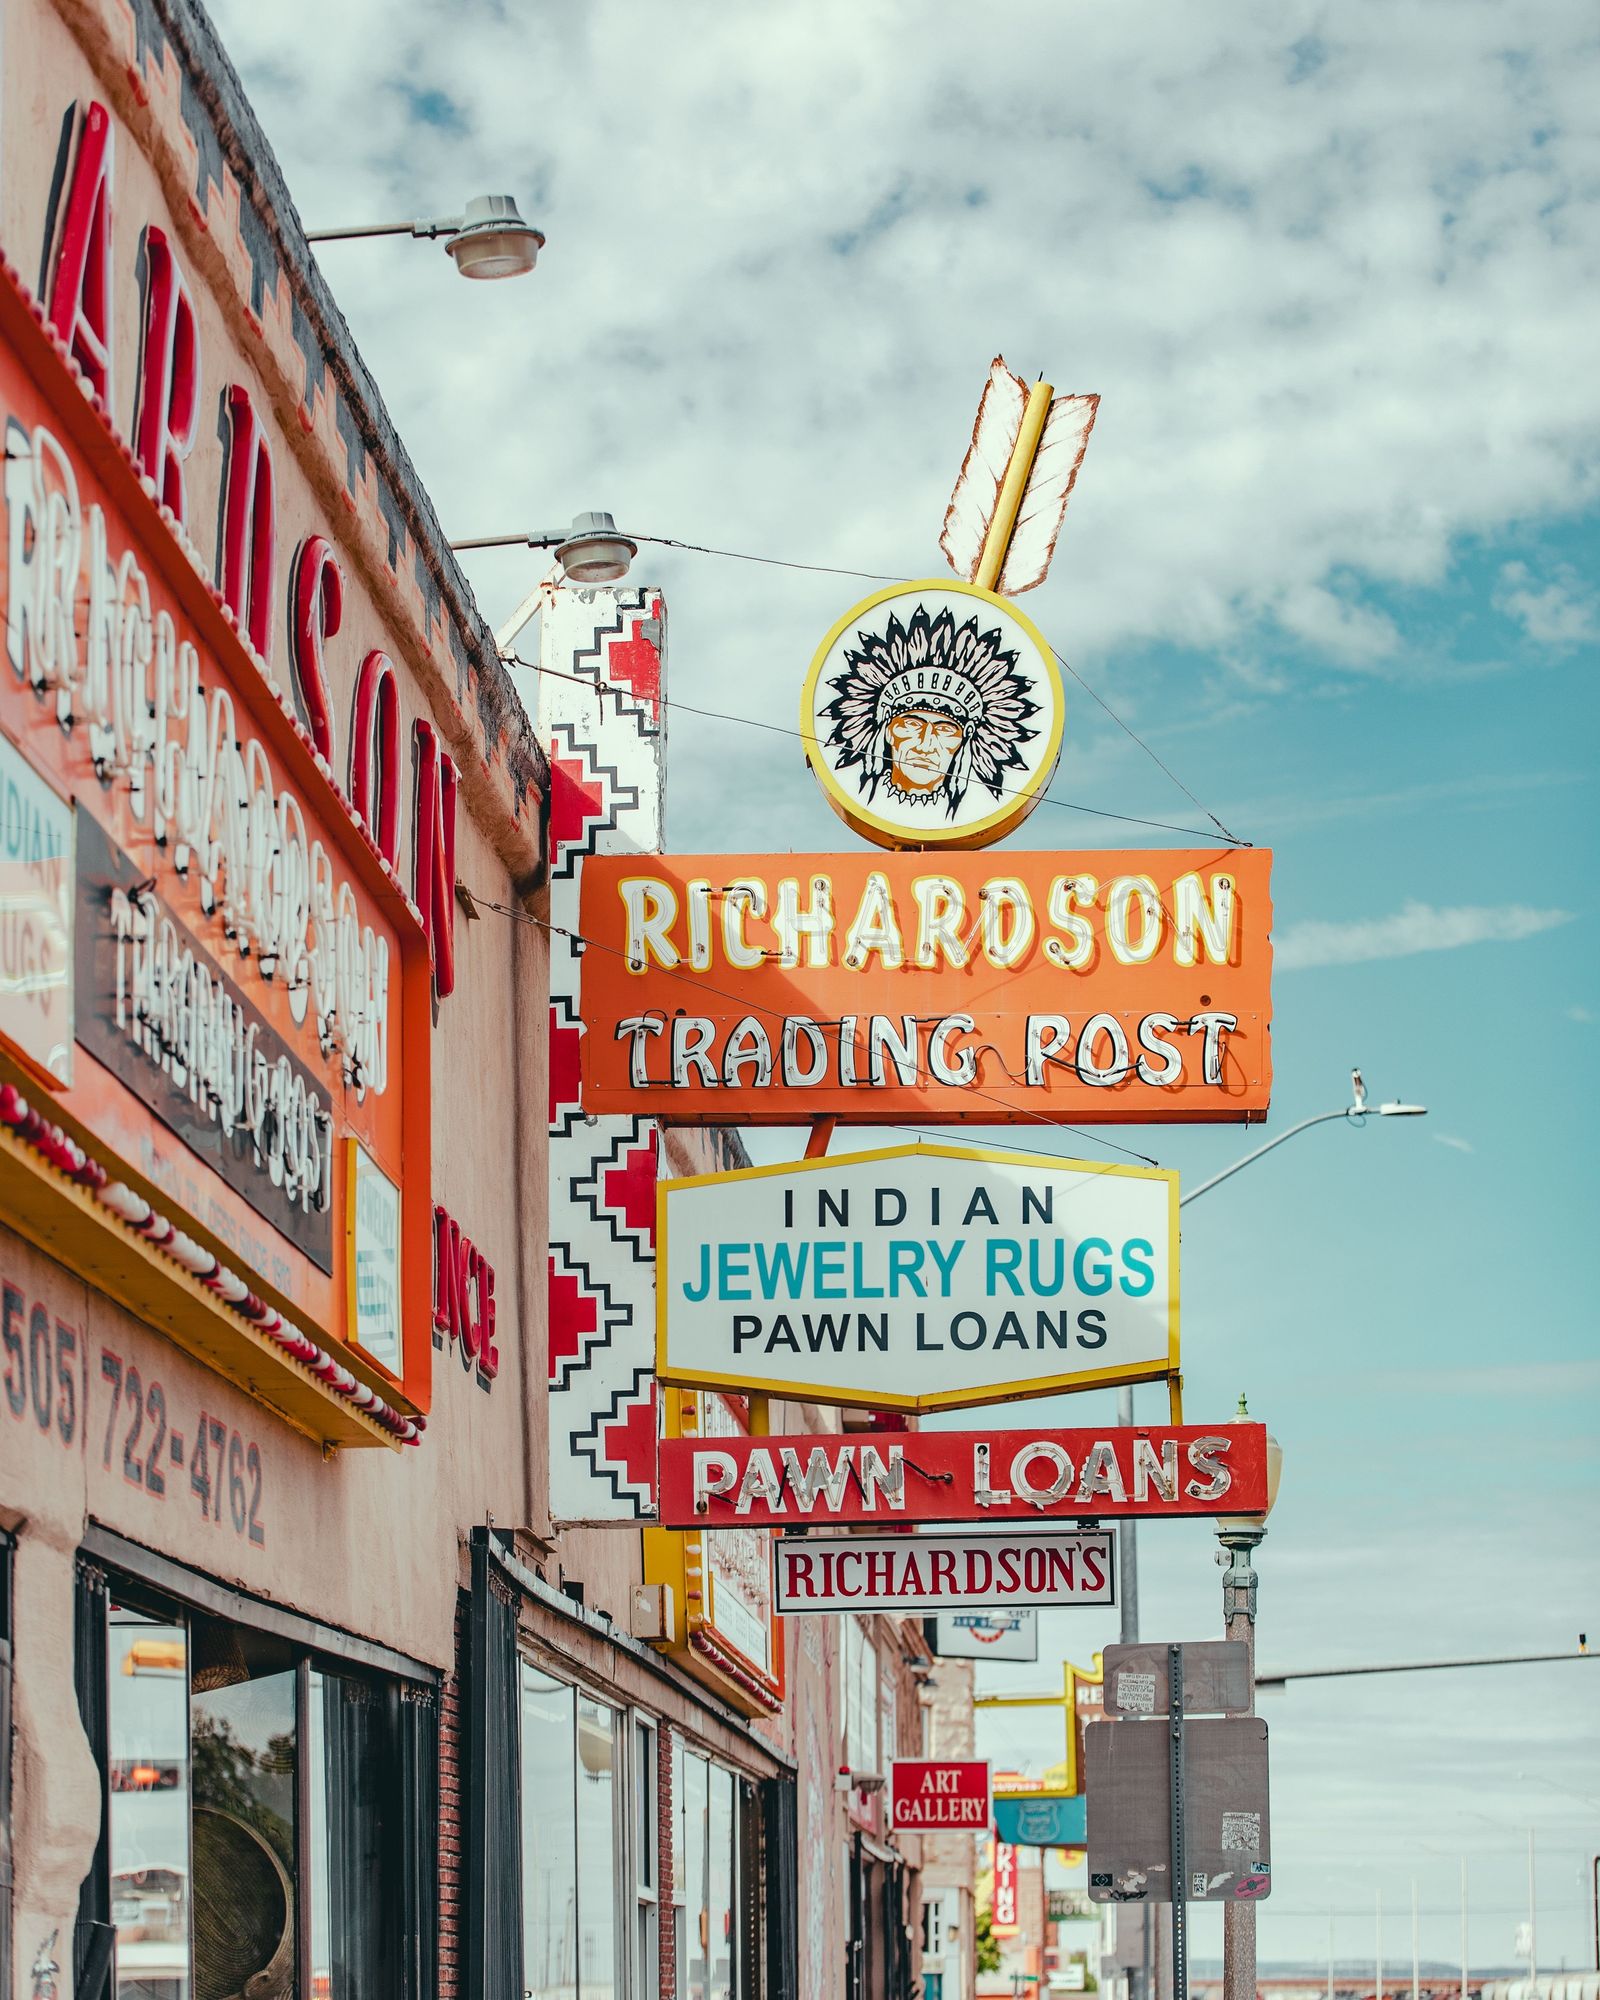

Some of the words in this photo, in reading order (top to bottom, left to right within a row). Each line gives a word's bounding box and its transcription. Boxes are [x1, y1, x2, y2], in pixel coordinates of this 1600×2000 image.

[0, 768, 61, 890] DIAN
[618, 870, 1236, 976] RICHARDSON
[615, 1012, 977, 1089] TRADING
[1025, 1012, 1238, 1087] POST
[784, 1185, 1054, 1229] INDIAN
[682, 1240, 966, 1302] JEWELRY
[984, 1237, 1155, 1298] RUGS
[732, 1312, 890, 1354] PAWN
[915, 1309, 1108, 1352] LOANS
[101, 1347, 266, 1552] 722-4762
[692, 1445, 906, 1516] PAWN
[973, 1436, 1232, 1510] LOANS
[785, 1541, 1106, 1598] RICHARDSON'S
[895, 1797, 986, 1823] GALLERY
[920, 1769, 962, 1794] ART
